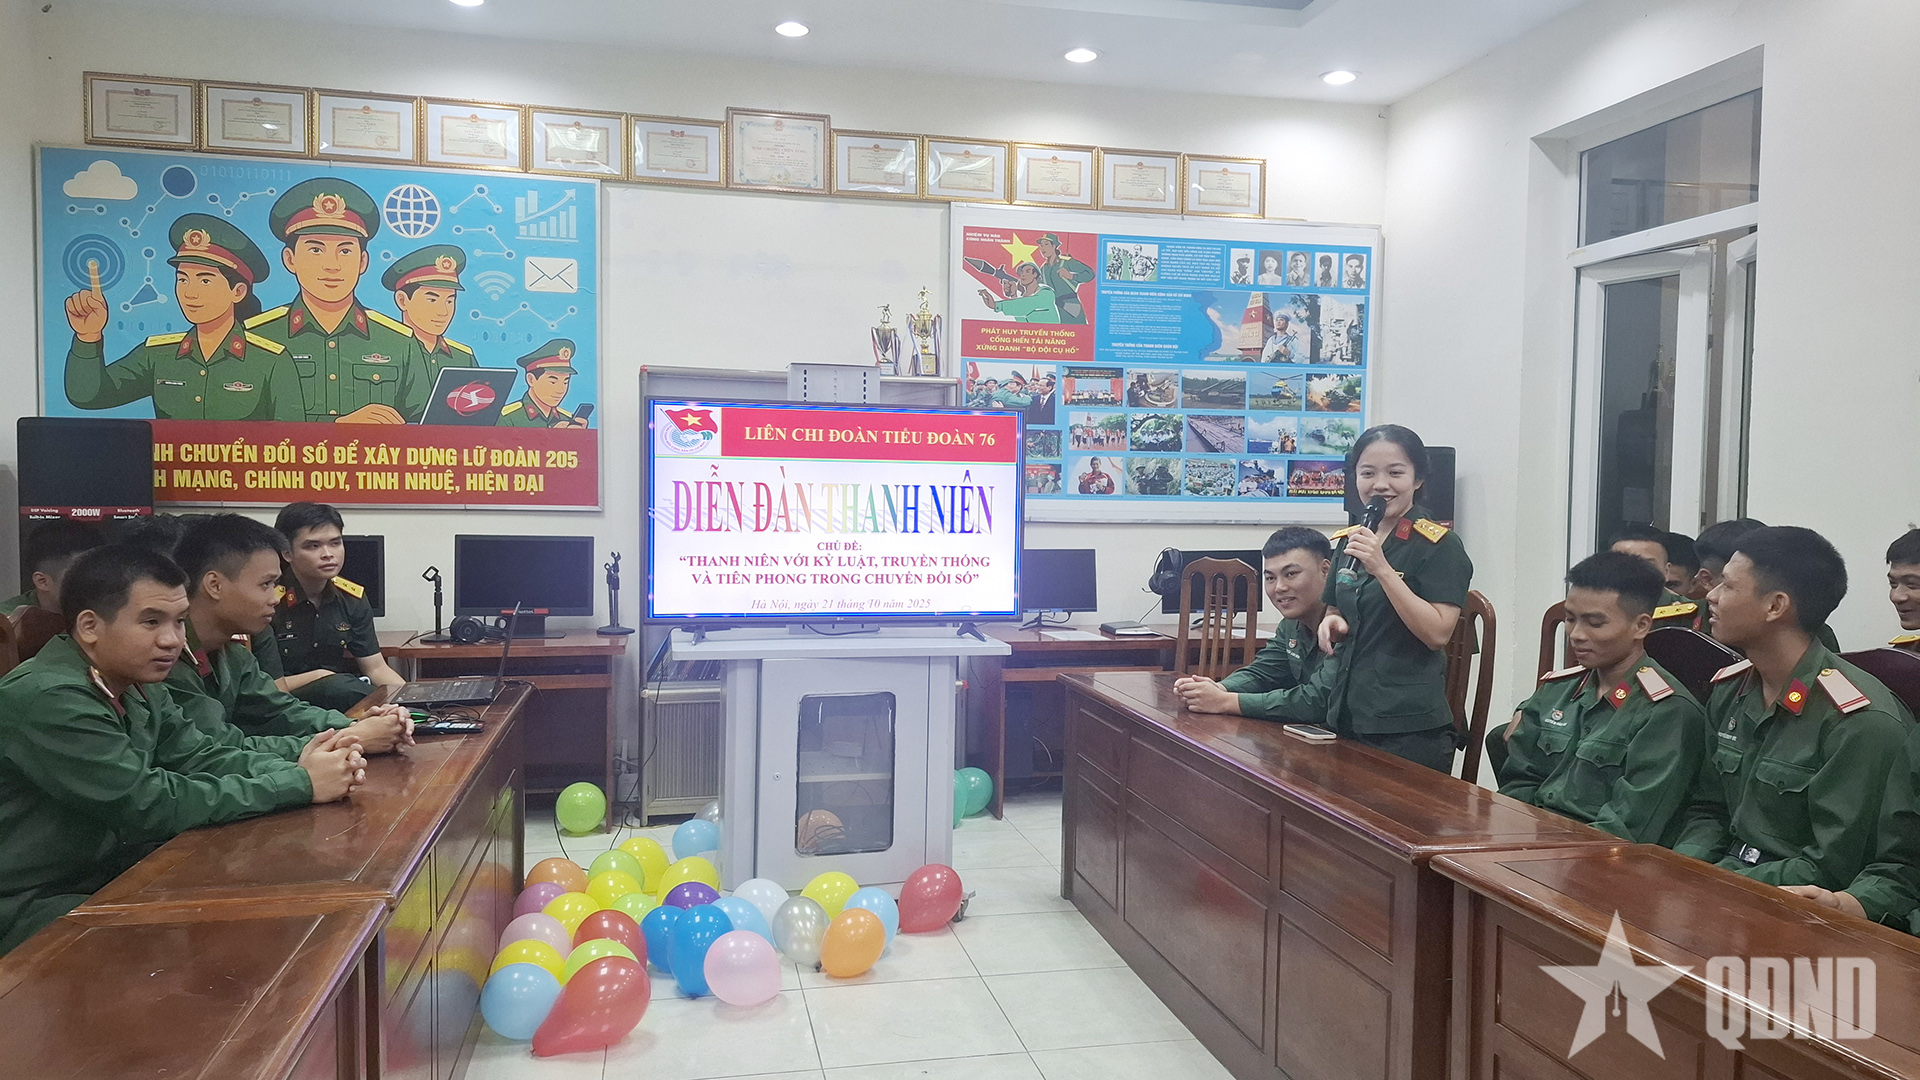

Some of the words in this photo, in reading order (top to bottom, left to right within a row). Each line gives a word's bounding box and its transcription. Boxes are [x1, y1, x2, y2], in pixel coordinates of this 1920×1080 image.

[744, 423, 787, 441] LIÊN
[791, 428, 824, 442] CHI
[828, 426, 878, 443] ĐOÀN
[927, 429, 975, 446] ĐOÀN
[979, 433, 996, 446] 76
[180, 437, 258, 463] CHUYỂN
[263, 438, 296, 464] ĐỔI
[302, 439, 328, 464] SỐ
[333, 439, 359, 465] ĐỂ
[364, 443, 401, 466] XÂY
[406, 446, 458, 470] DỰNG
[463, 445, 488, 467] LỮ
[490, 446, 541, 468] ĐOÀN
[545, 451, 578, 468] 205
[173, 469, 239, 492] MẠNG,
[244, 466, 305, 489] CHÍNH
[310, 471, 350, 492] QUY,
[356, 471, 399, 490] TINH
[405, 469, 460, 495] NHUỆ,
[466, 470, 509, 495] HIỆN
[513, 473, 544, 496] ĐẠI
[672, 464, 745, 533] DIỄN
[753, 465, 814, 533] ĐÀN
[821, 483, 922, 534] THANH
[928, 469, 995, 535] NIÊN
[71, 508, 100, 517] 2000W
[817, 540, 841, 551] CHỦ
[679, 555, 740, 567] “THANH
[744, 553, 779, 567] NIÊN
[784, 553, 809, 567] VỚI
[837, 554, 878, 569] LUẬT,
[881, 553, 938, 567] TRUYỀN
[941, 553, 990, 568] THỐNG
[692, 570, 712, 584] VÀ
[716, 570, 751, 584] TIÊN
[755, 573, 807, 585] PHONG
[810, 573, 861, 584] TRONG
[864, 571, 923, 584] CHUYỂN
[926, 571, 951, 584] ĐỔI
[751, 599, 767, 609] Hà
[794, 601, 819, 611] ngày
[822, 599, 834, 609] 21
[836, 599, 866, 611] tháng
[882, 600, 904, 609] năm
[907, 599, 931, 609] 2025
